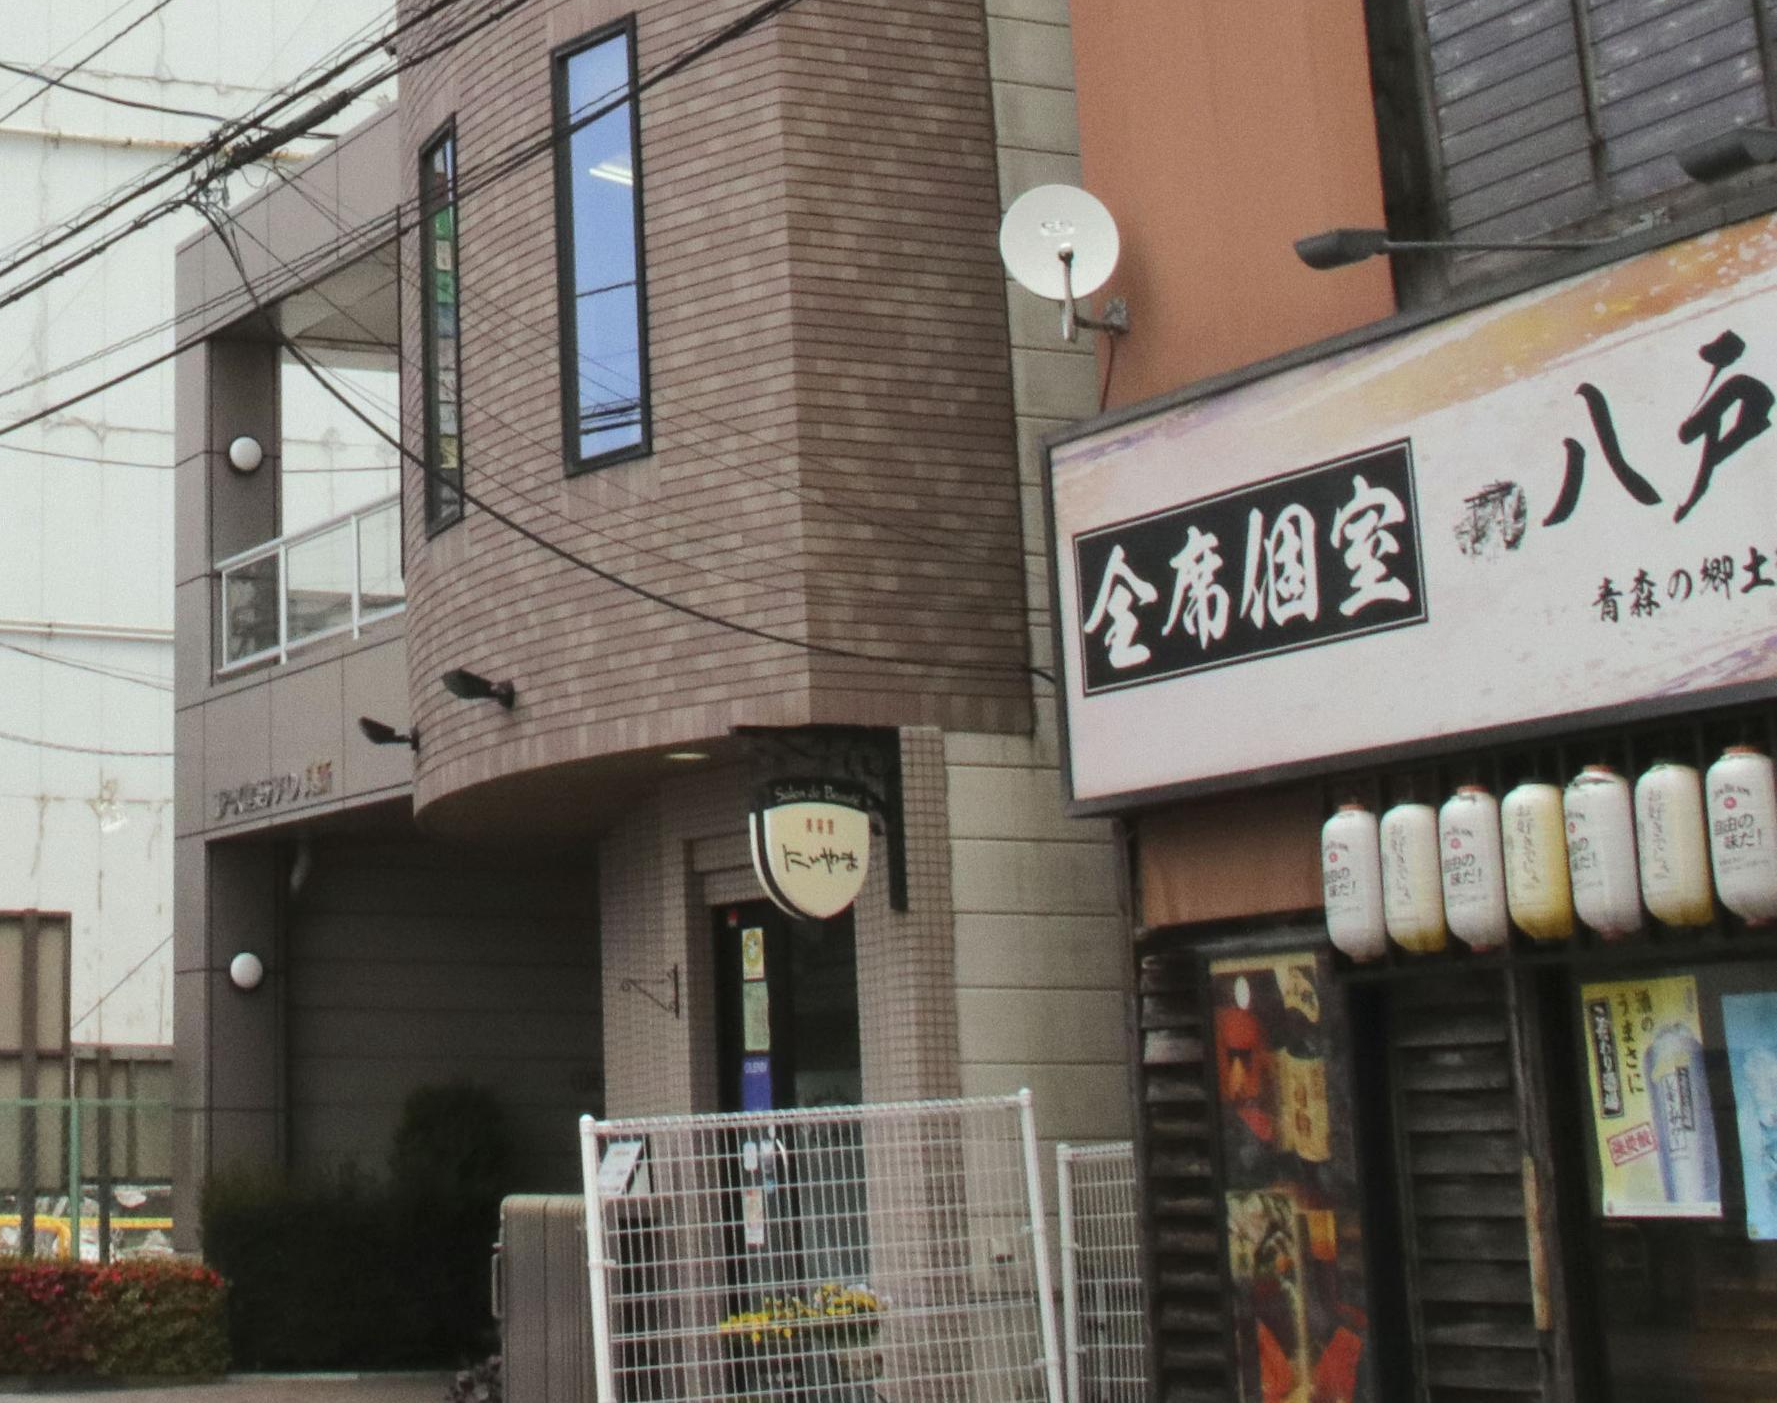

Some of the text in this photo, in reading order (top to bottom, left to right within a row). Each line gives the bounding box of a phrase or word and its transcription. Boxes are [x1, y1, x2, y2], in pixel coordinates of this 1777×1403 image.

[1542, 329, 1776, 527] 八戸
[1083, 474, 1412, 670] 全席個室
[1592, 546, 1777, 623] 青森の郷土
